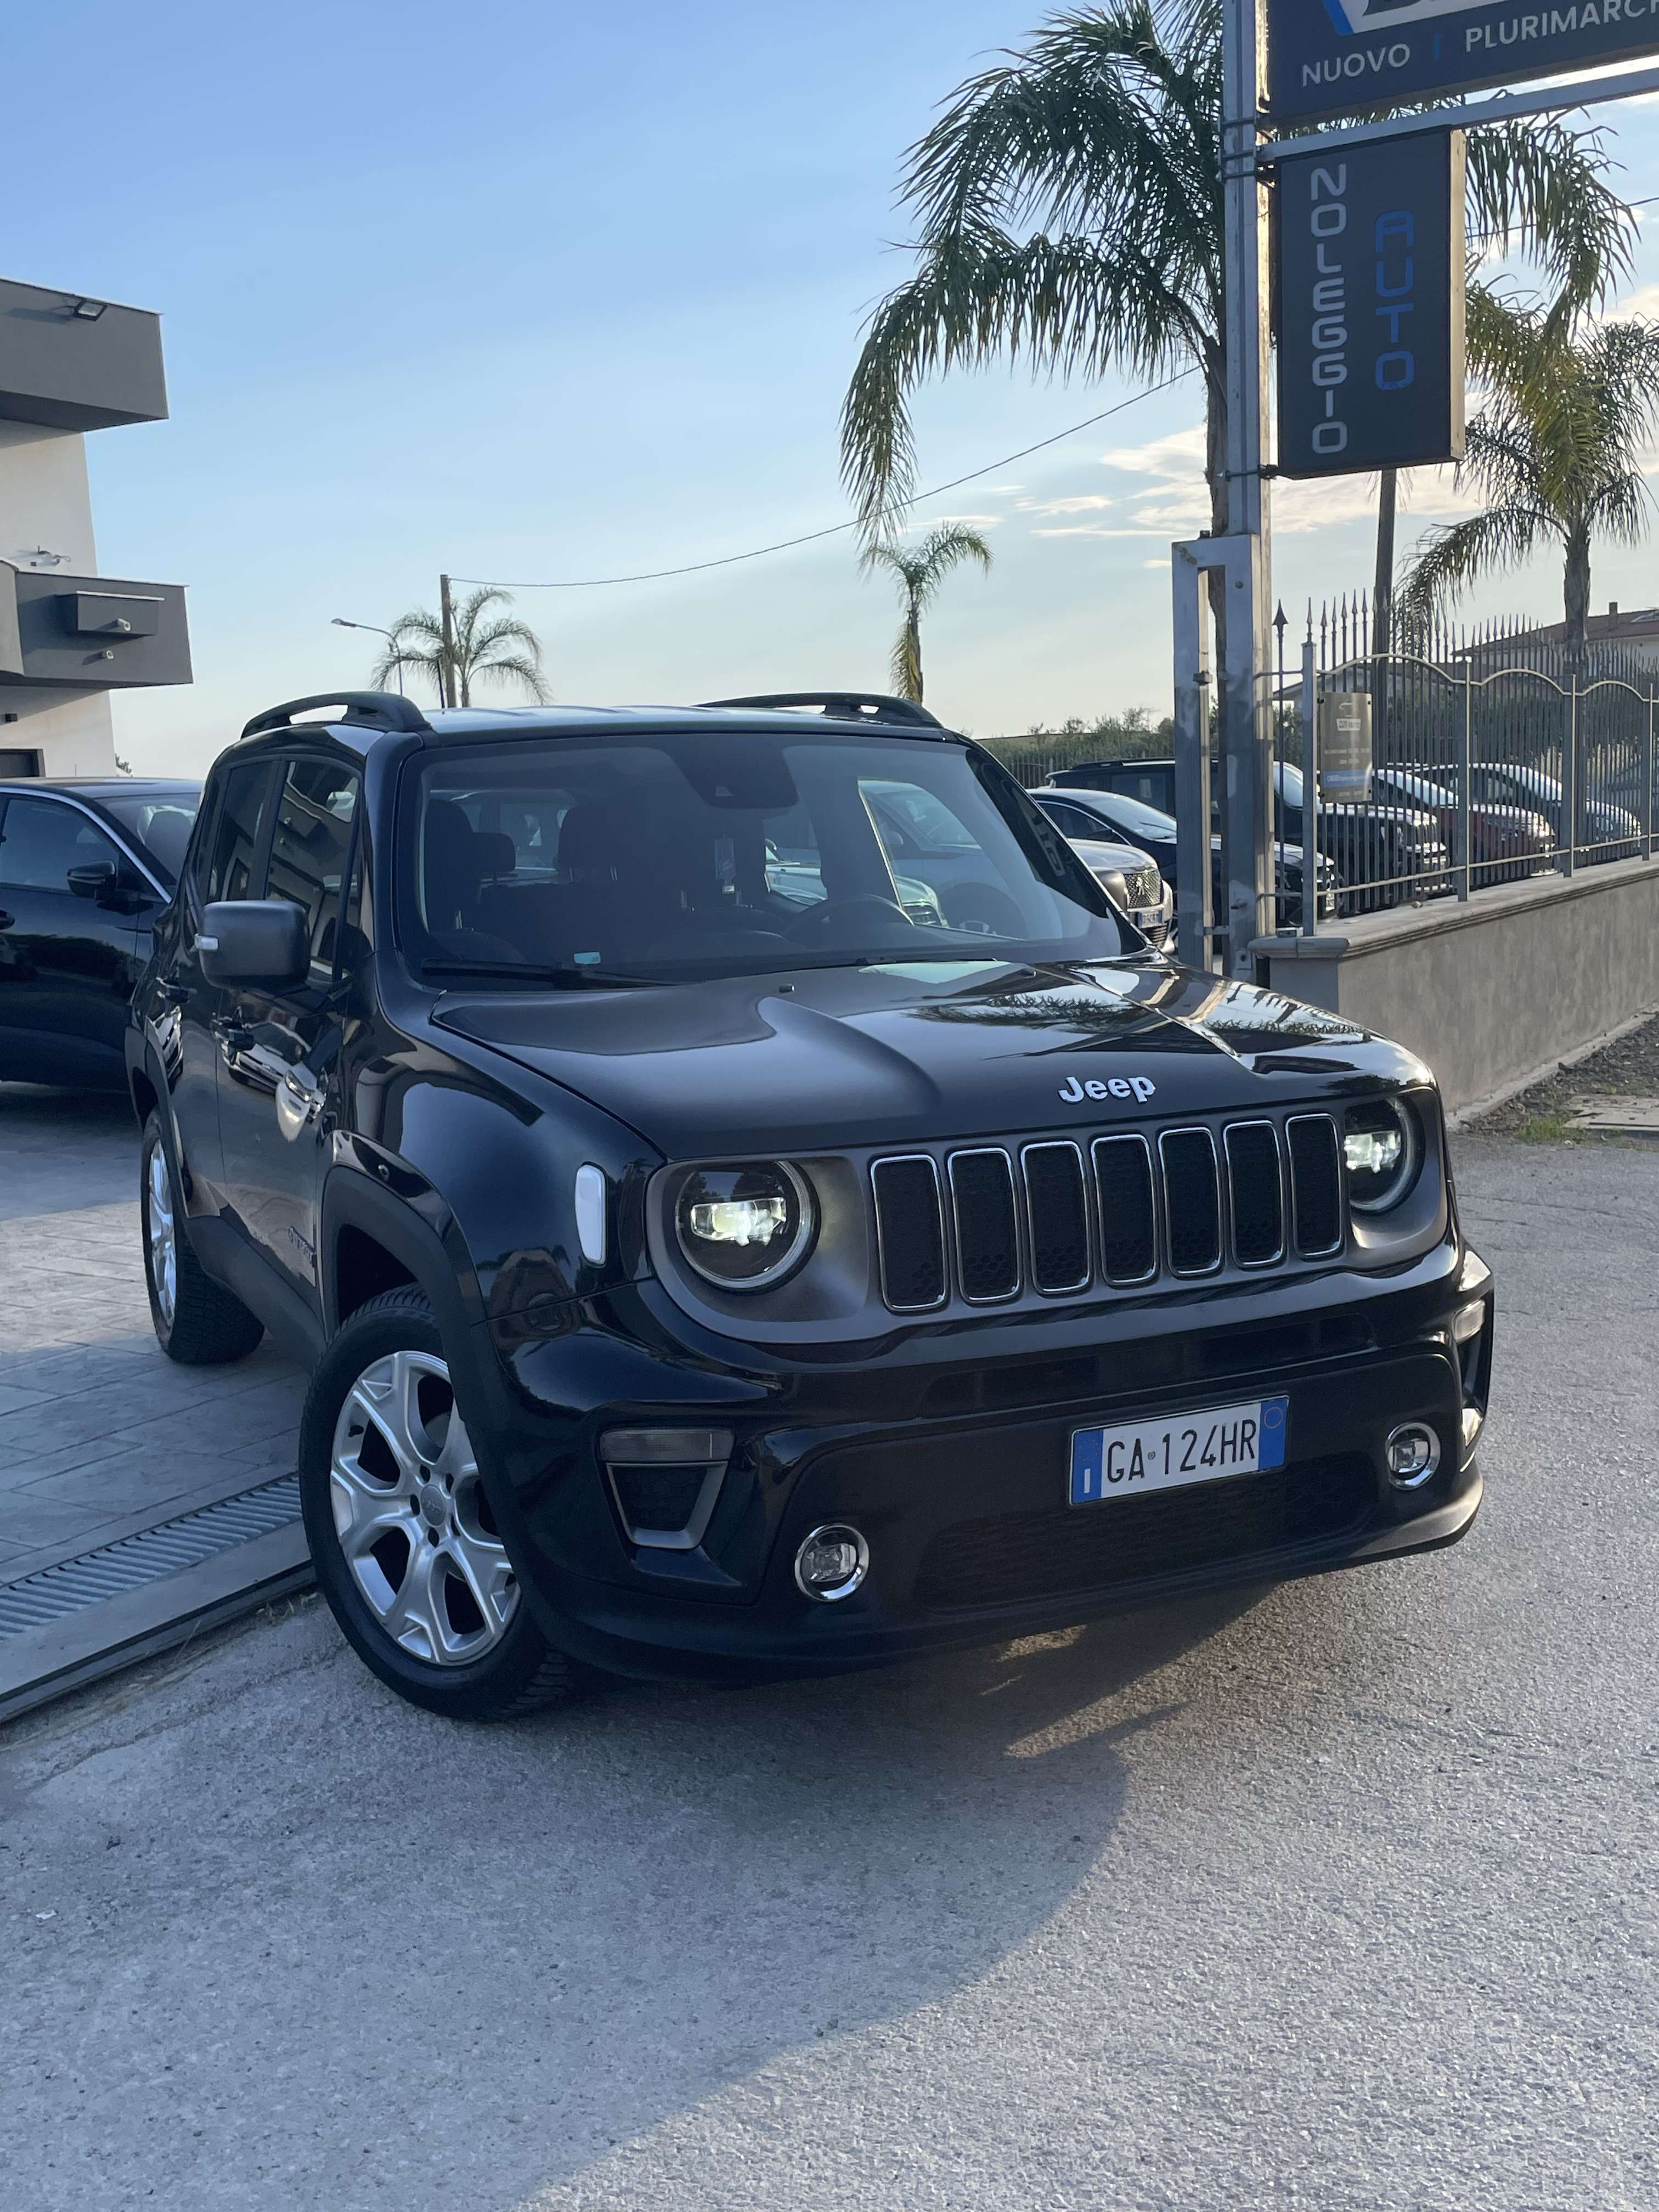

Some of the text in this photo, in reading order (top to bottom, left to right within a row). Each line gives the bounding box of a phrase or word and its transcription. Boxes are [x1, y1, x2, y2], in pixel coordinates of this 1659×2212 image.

[1302, 43, 1410, 87] NUOVO
[1310, 163, 1348, 454] NOLEGGIO
[1375, 210, 1414, 390] AUTO
[1058, 1076, 1156, 1103] Jeep
[1084, 1468, 1091, 1494] I
